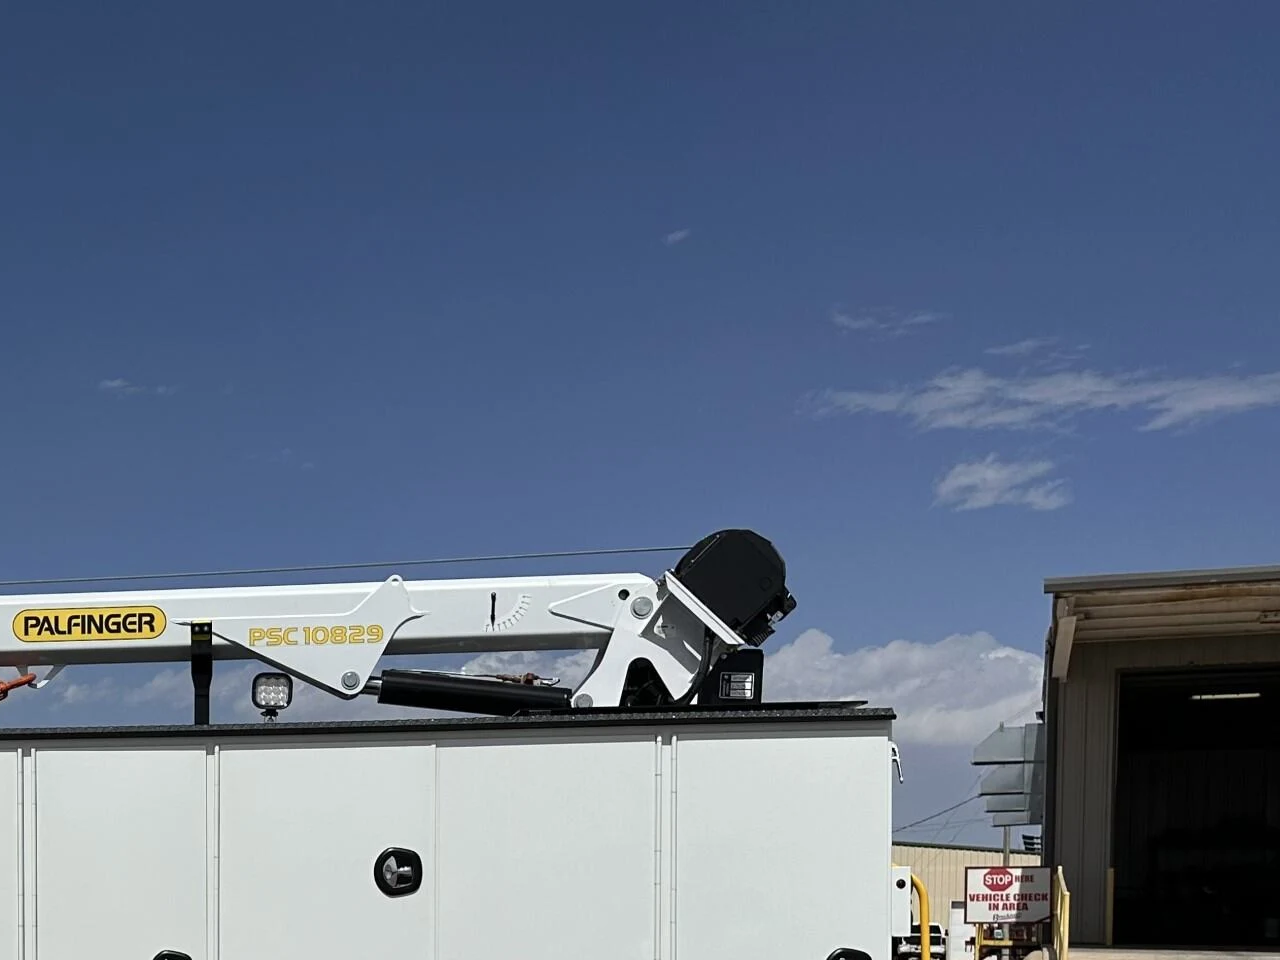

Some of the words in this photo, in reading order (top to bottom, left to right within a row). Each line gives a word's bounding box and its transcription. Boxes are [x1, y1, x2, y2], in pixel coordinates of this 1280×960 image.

[23, 612, 156, 637] PALFINGER
[248, 626, 300, 647] PSC
[302, 624, 385, 646] 10829
[985, 874, 1011, 885] STOP
[1015, 875, 1034, 883] HERE
[969, 893, 1011, 902] VEHICLE
[1013, 892, 1049, 902] CHECK
[988, 902, 1000, 911] IN
[1001, 902, 1029, 911] AREA
